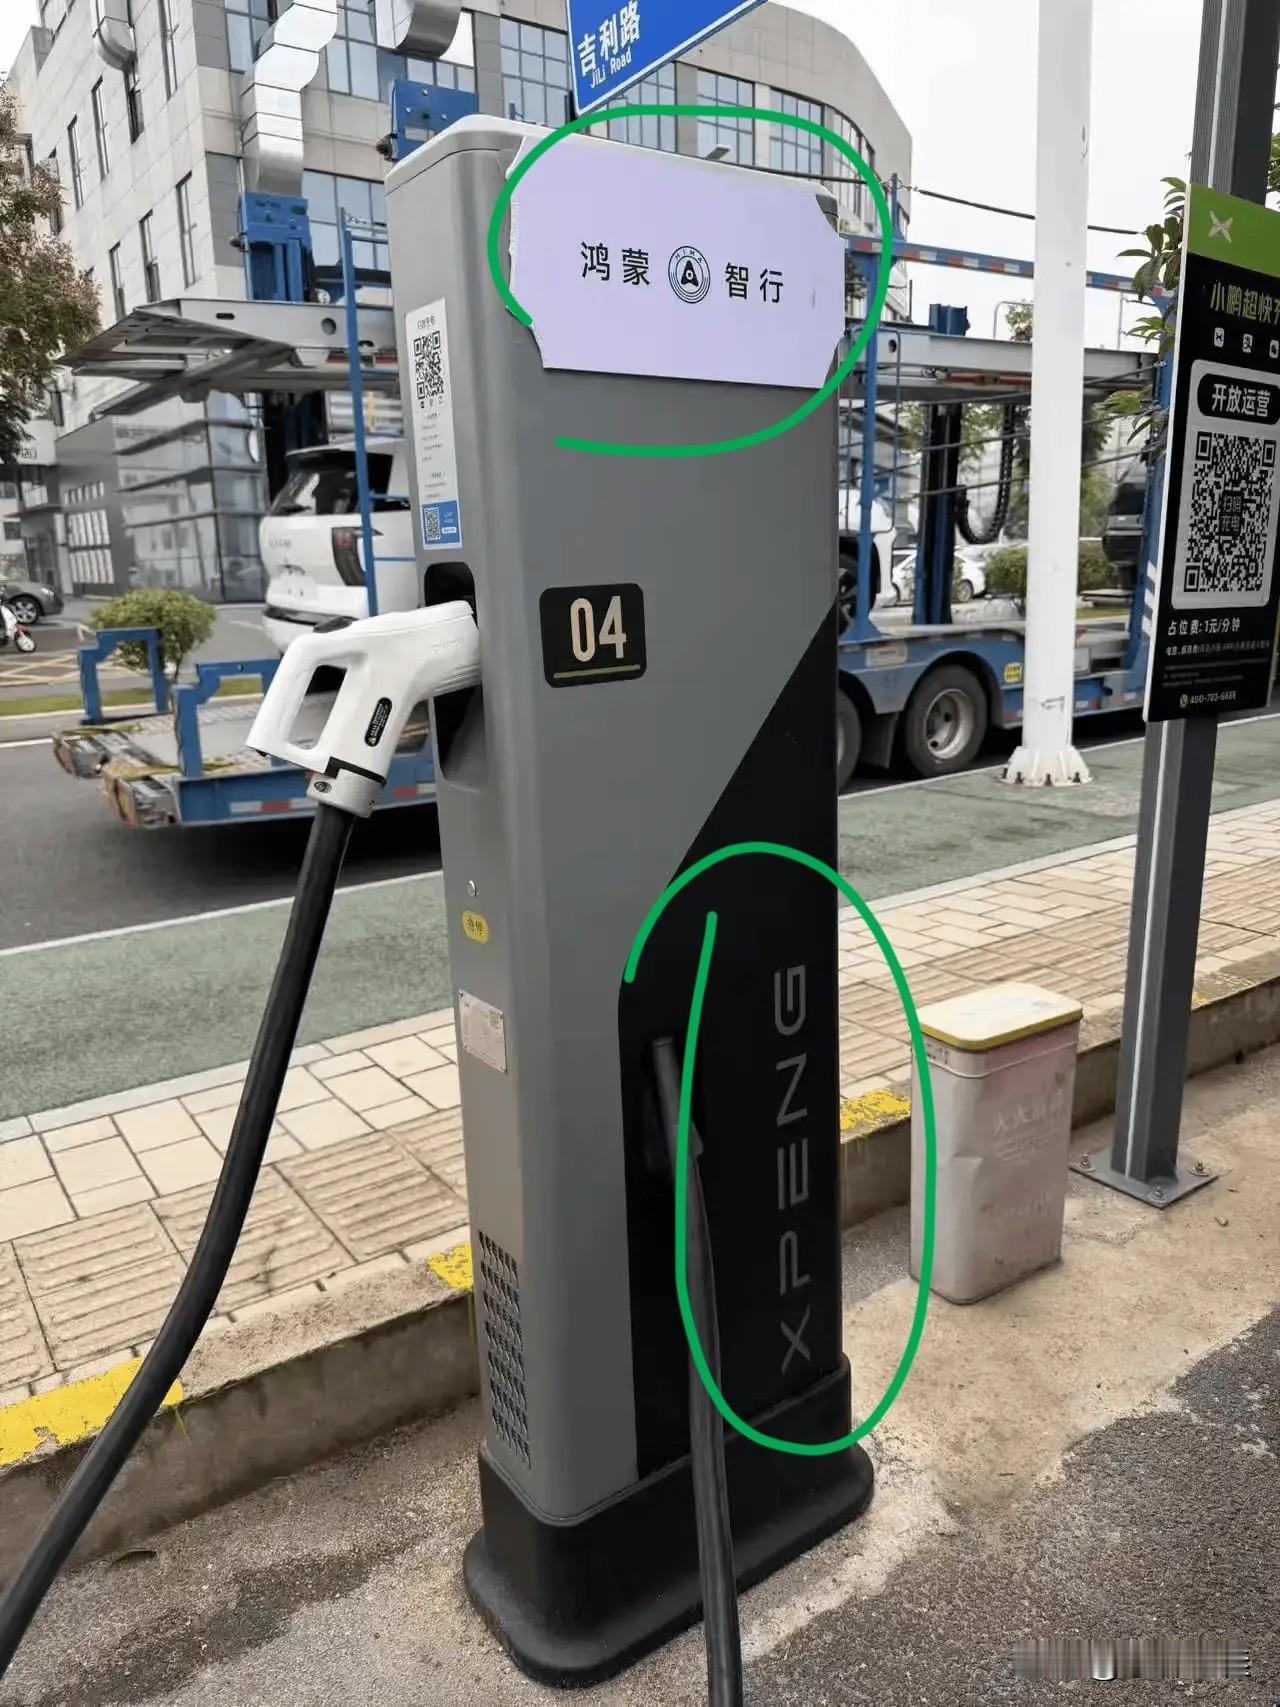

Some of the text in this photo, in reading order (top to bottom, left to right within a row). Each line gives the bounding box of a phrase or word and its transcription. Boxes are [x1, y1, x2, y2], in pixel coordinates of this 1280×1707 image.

[577, 0, 640, 77] 吉利路
[610, 46, 632, 75] Road
[579, 241, 784, 304] 鸿蒙 智行
[1211, 383, 1271, 418] 开放运营
[569, 594, 627, 663] 04
[773, 963, 811, 1376] XPENG
